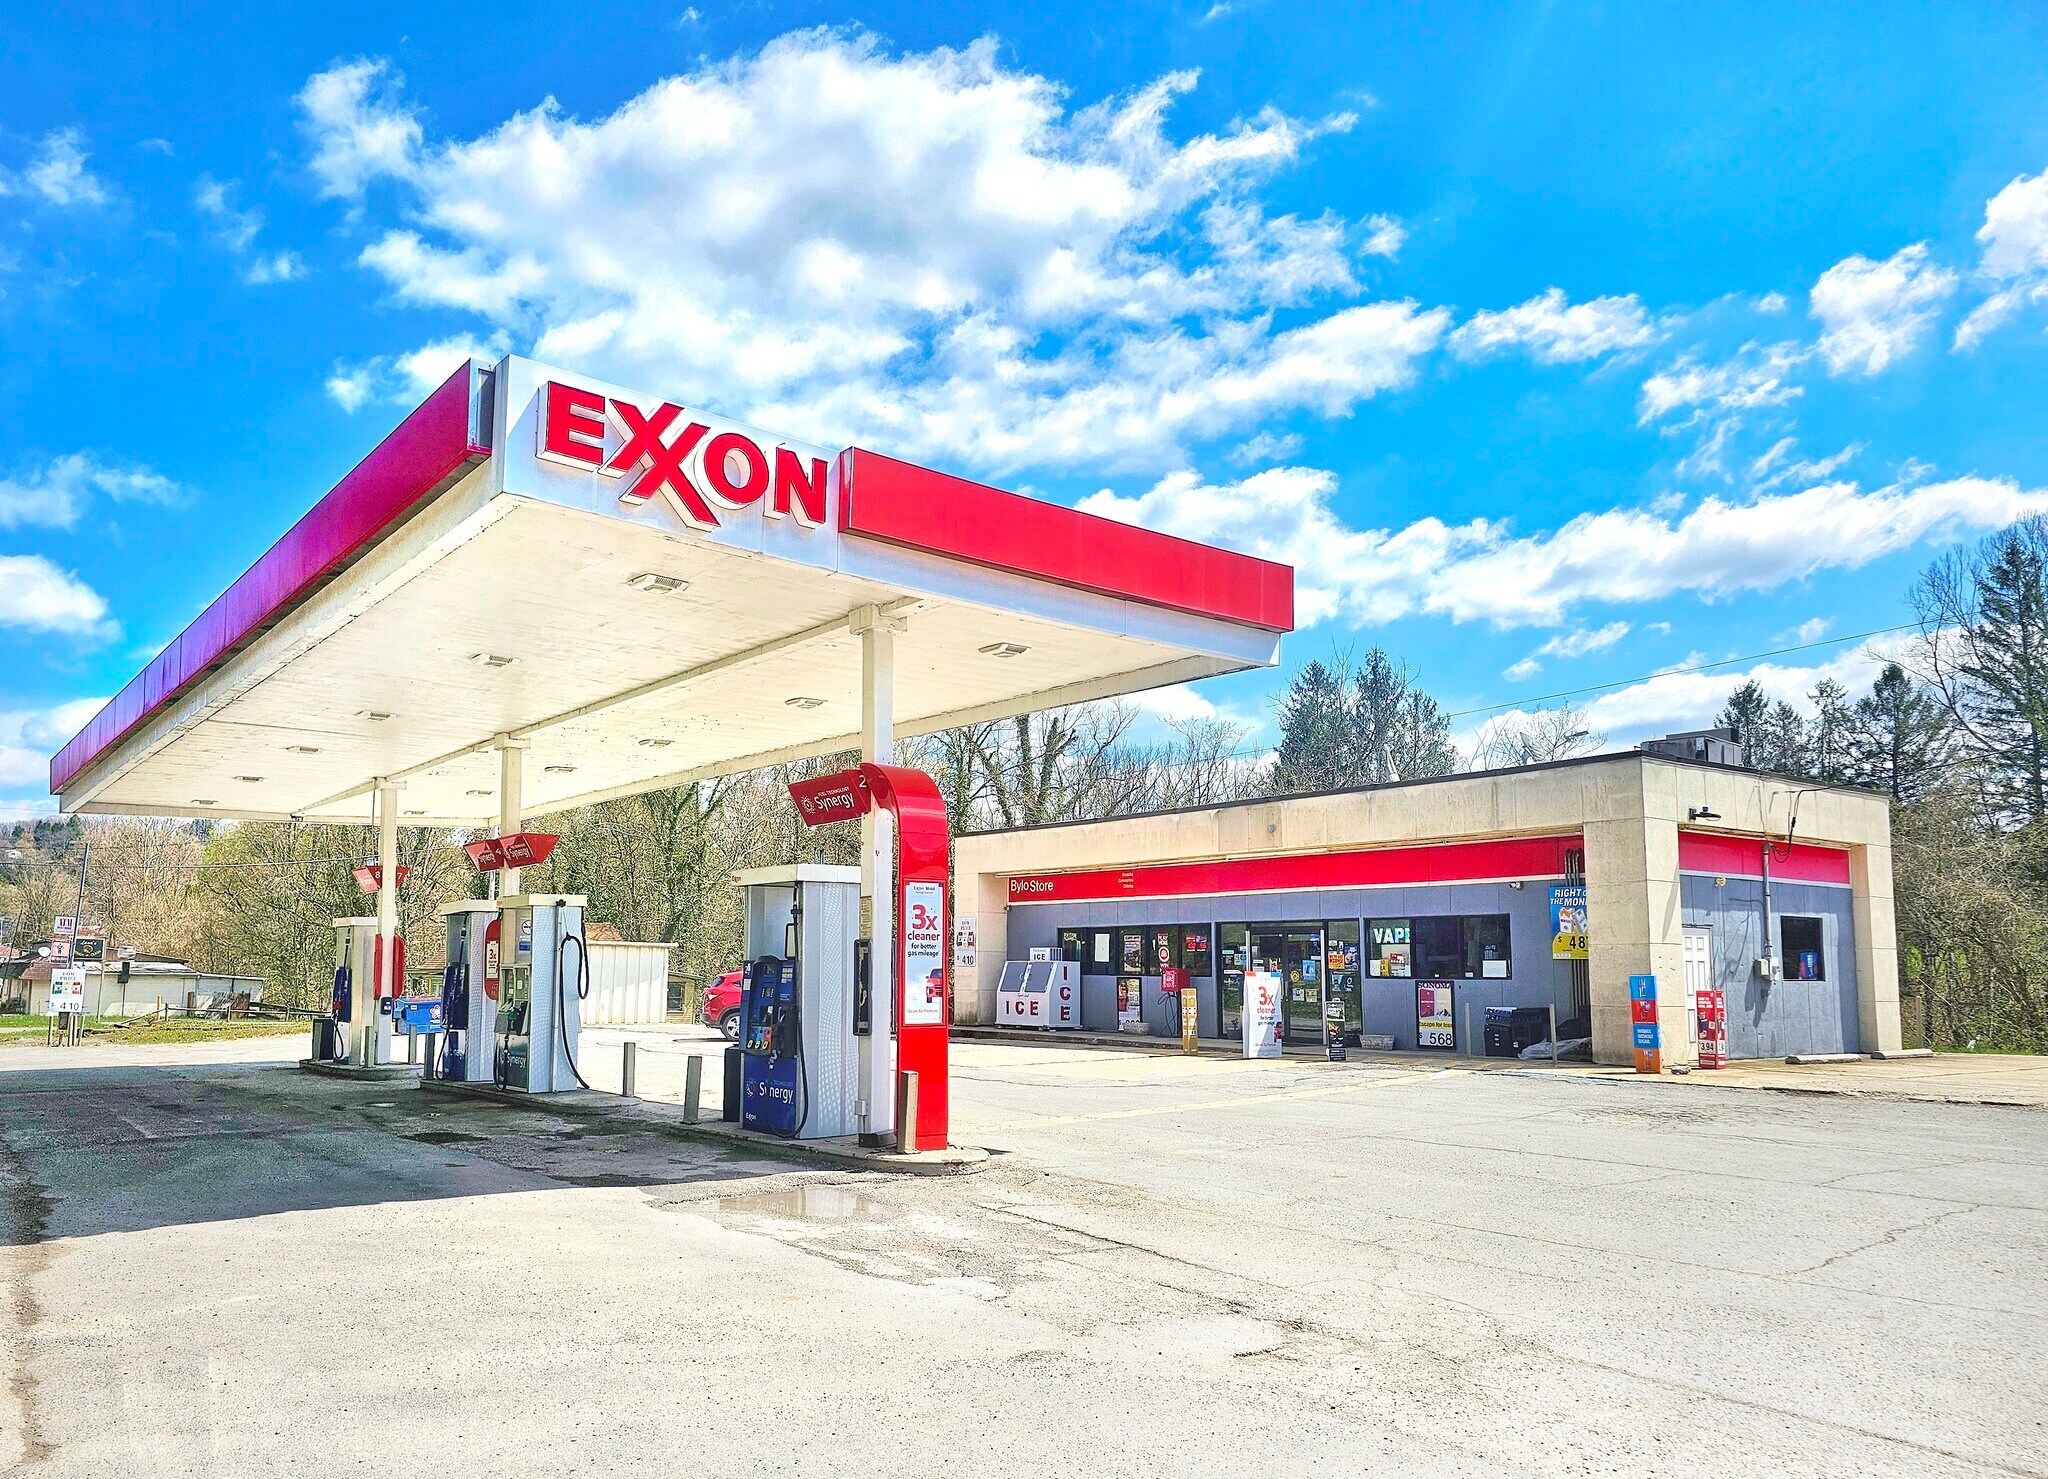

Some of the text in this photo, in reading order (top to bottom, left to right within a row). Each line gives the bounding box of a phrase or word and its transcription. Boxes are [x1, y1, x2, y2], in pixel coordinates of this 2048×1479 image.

[543, 380, 829, 529] EXXON
[858, 774, 867, 788] 2
[826, 786, 850, 796] TECHNOLOGY
[813, 793, 855, 812] Synergy
[495, 847, 502, 855] 4
[508, 847, 531, 860] Synergy
[374, 871, 381, 880] 8
[397, 872, 403, 880] 7
[1010, 879, 1054, 894] Bylo Store
[1554, 889, 1583, 898] RIGHT
[1563, 897, 1588, 907] MON
[911, 904, 938, 931] 3x
[907, 932, 940, 941] cleaner
[1059, 964, 1072, 1021] ICE
[1258, 985, 1275, 1006] 3x
[1005, 1000, 1039, 1016] ICE
